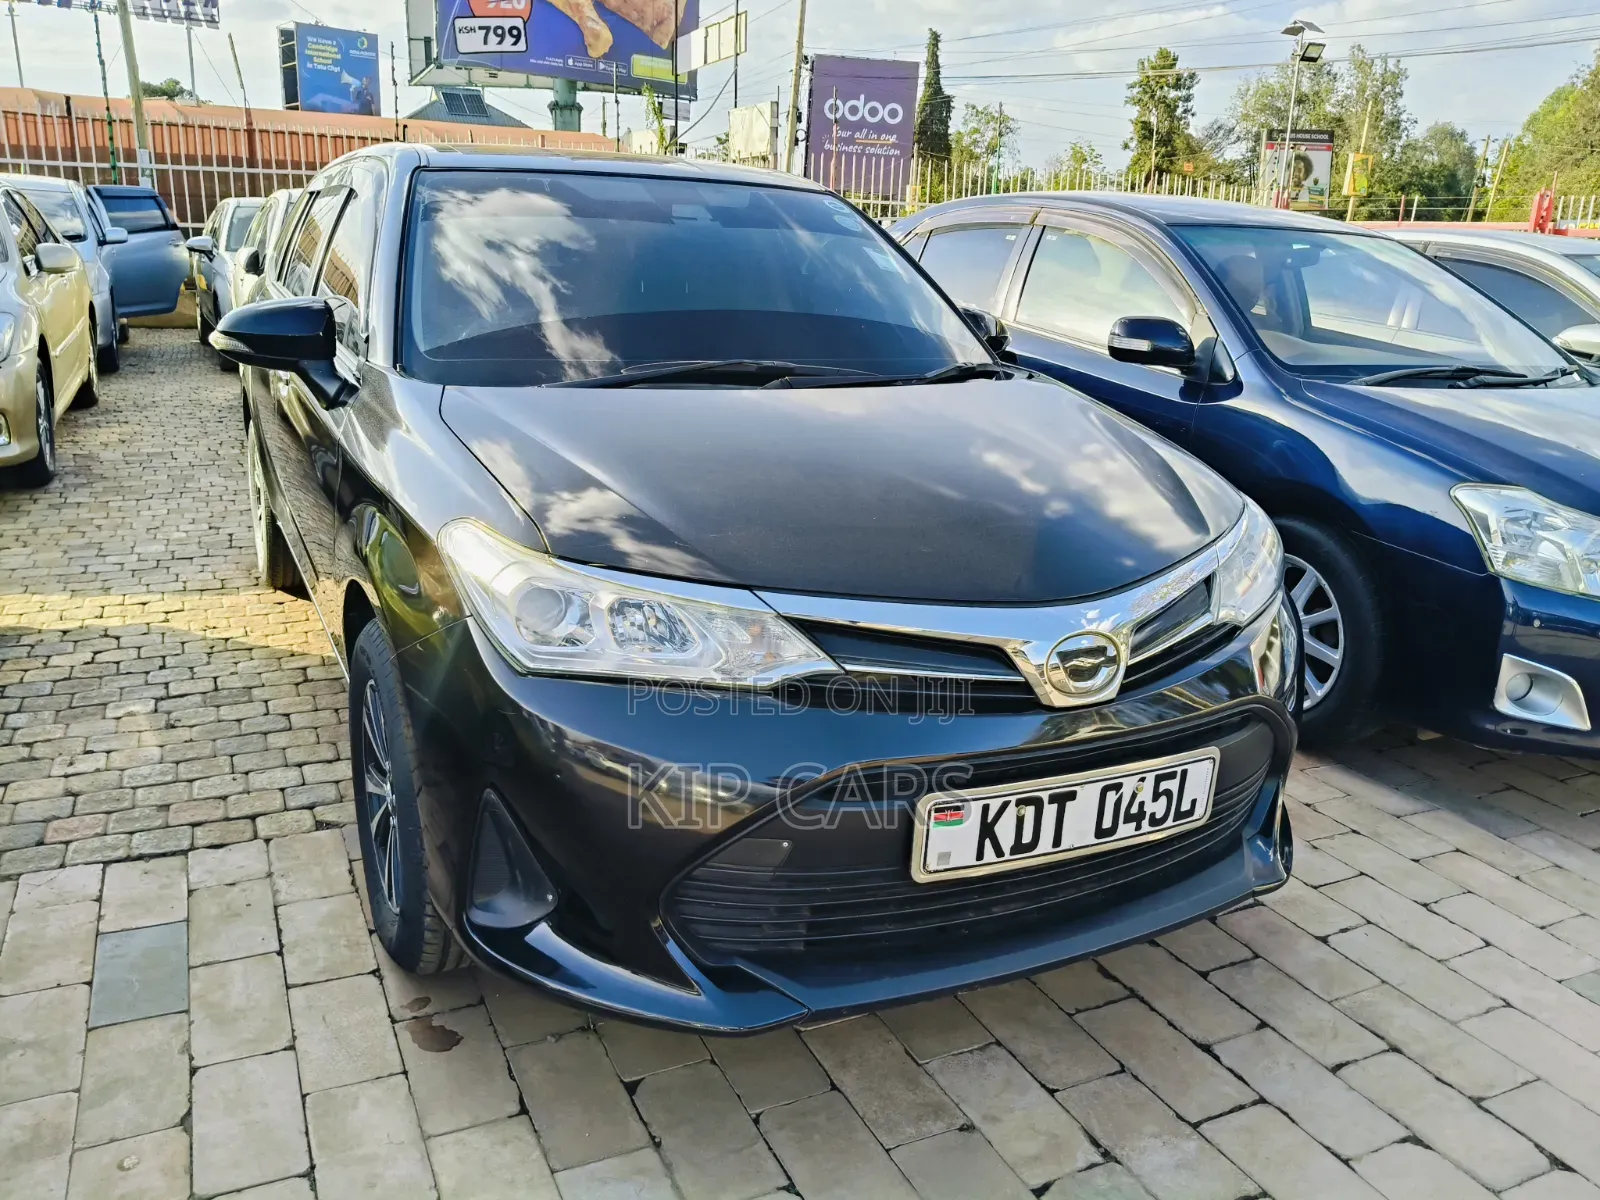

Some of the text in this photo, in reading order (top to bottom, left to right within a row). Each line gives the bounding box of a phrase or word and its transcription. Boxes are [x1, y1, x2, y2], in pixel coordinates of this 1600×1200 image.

[458, 25, 522, 46] KSH 799
[824, 94, 903, 124] odoo
[854, 128, 867, 138] all
[868, 131, 877, 140] in
[881, 133, 897, 141] one
[865, 144, 900, 156] solution
[975, 789, 1077, 861] KDT
[1094, 768, 1197, 839] 045L
